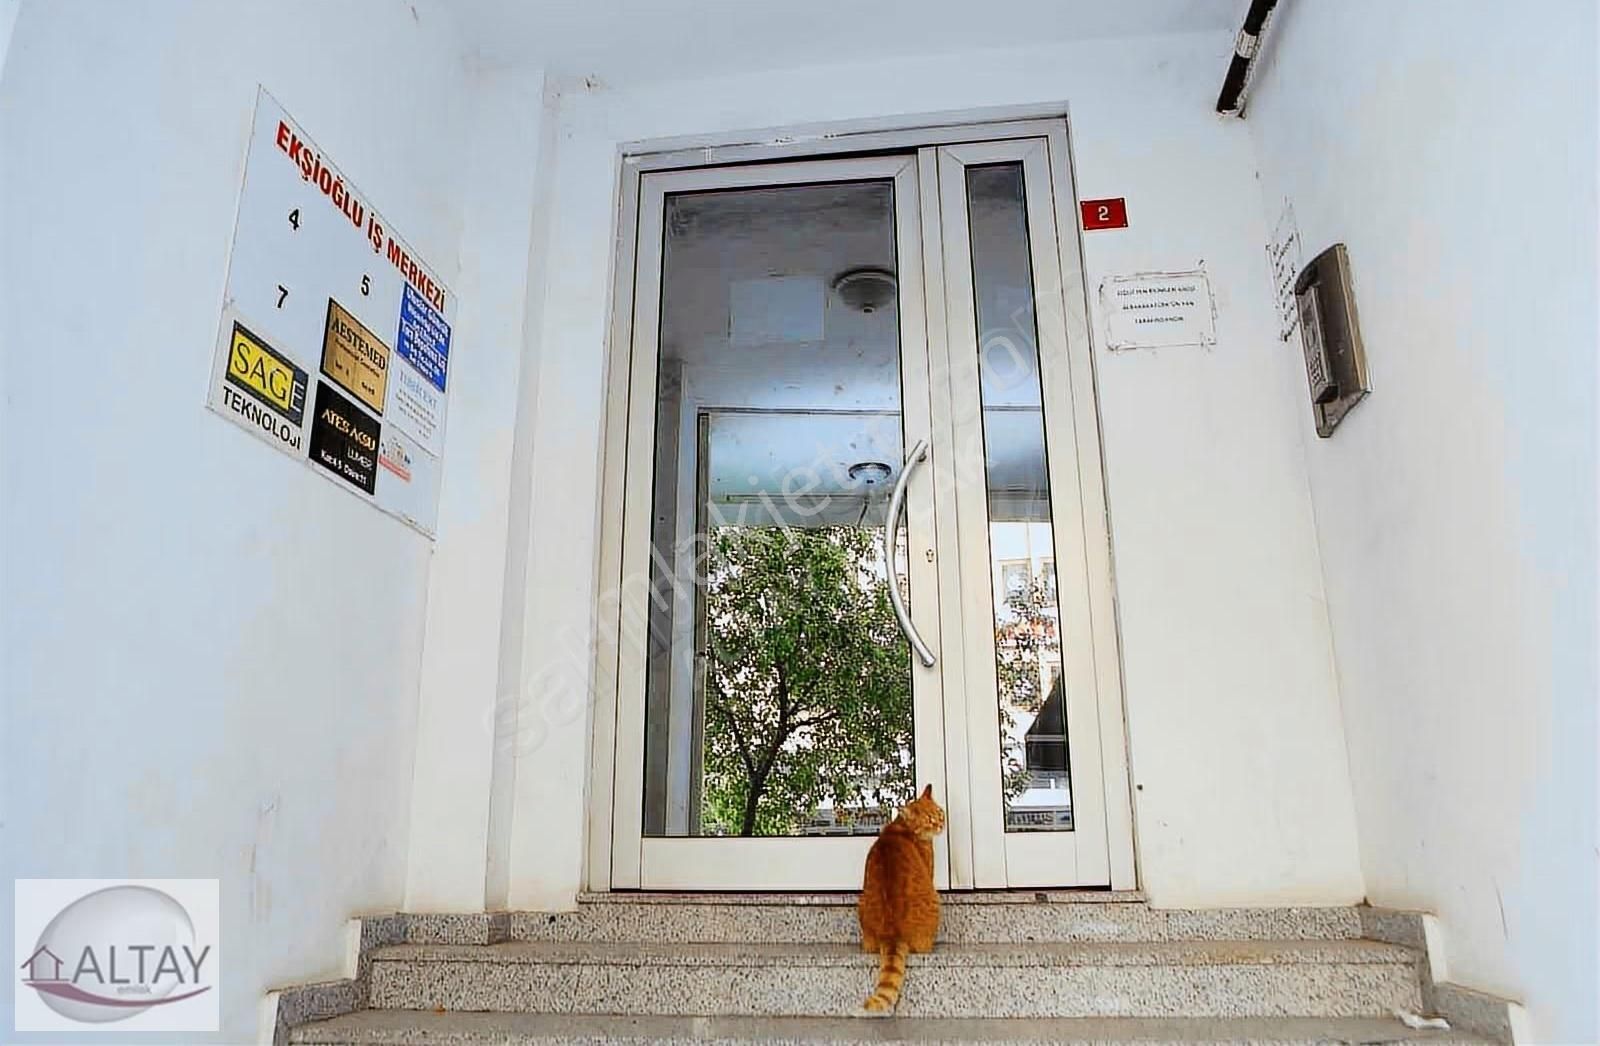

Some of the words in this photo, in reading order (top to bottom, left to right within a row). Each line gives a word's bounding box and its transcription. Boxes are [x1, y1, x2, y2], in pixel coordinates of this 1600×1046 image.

[275, 119, 364, 229] EKŞİOĞLU
[367, 211, 384, 254] İŞ
[386, 236, 446, 314] MERKEZİ
[288, 208, 300, 231] 4
[1097, 205, 1110, 222] 2
[276, 284, 289, 308] 7
[360, 274, 371, 296] 5
[234, 341, 306, 412] SAGE
